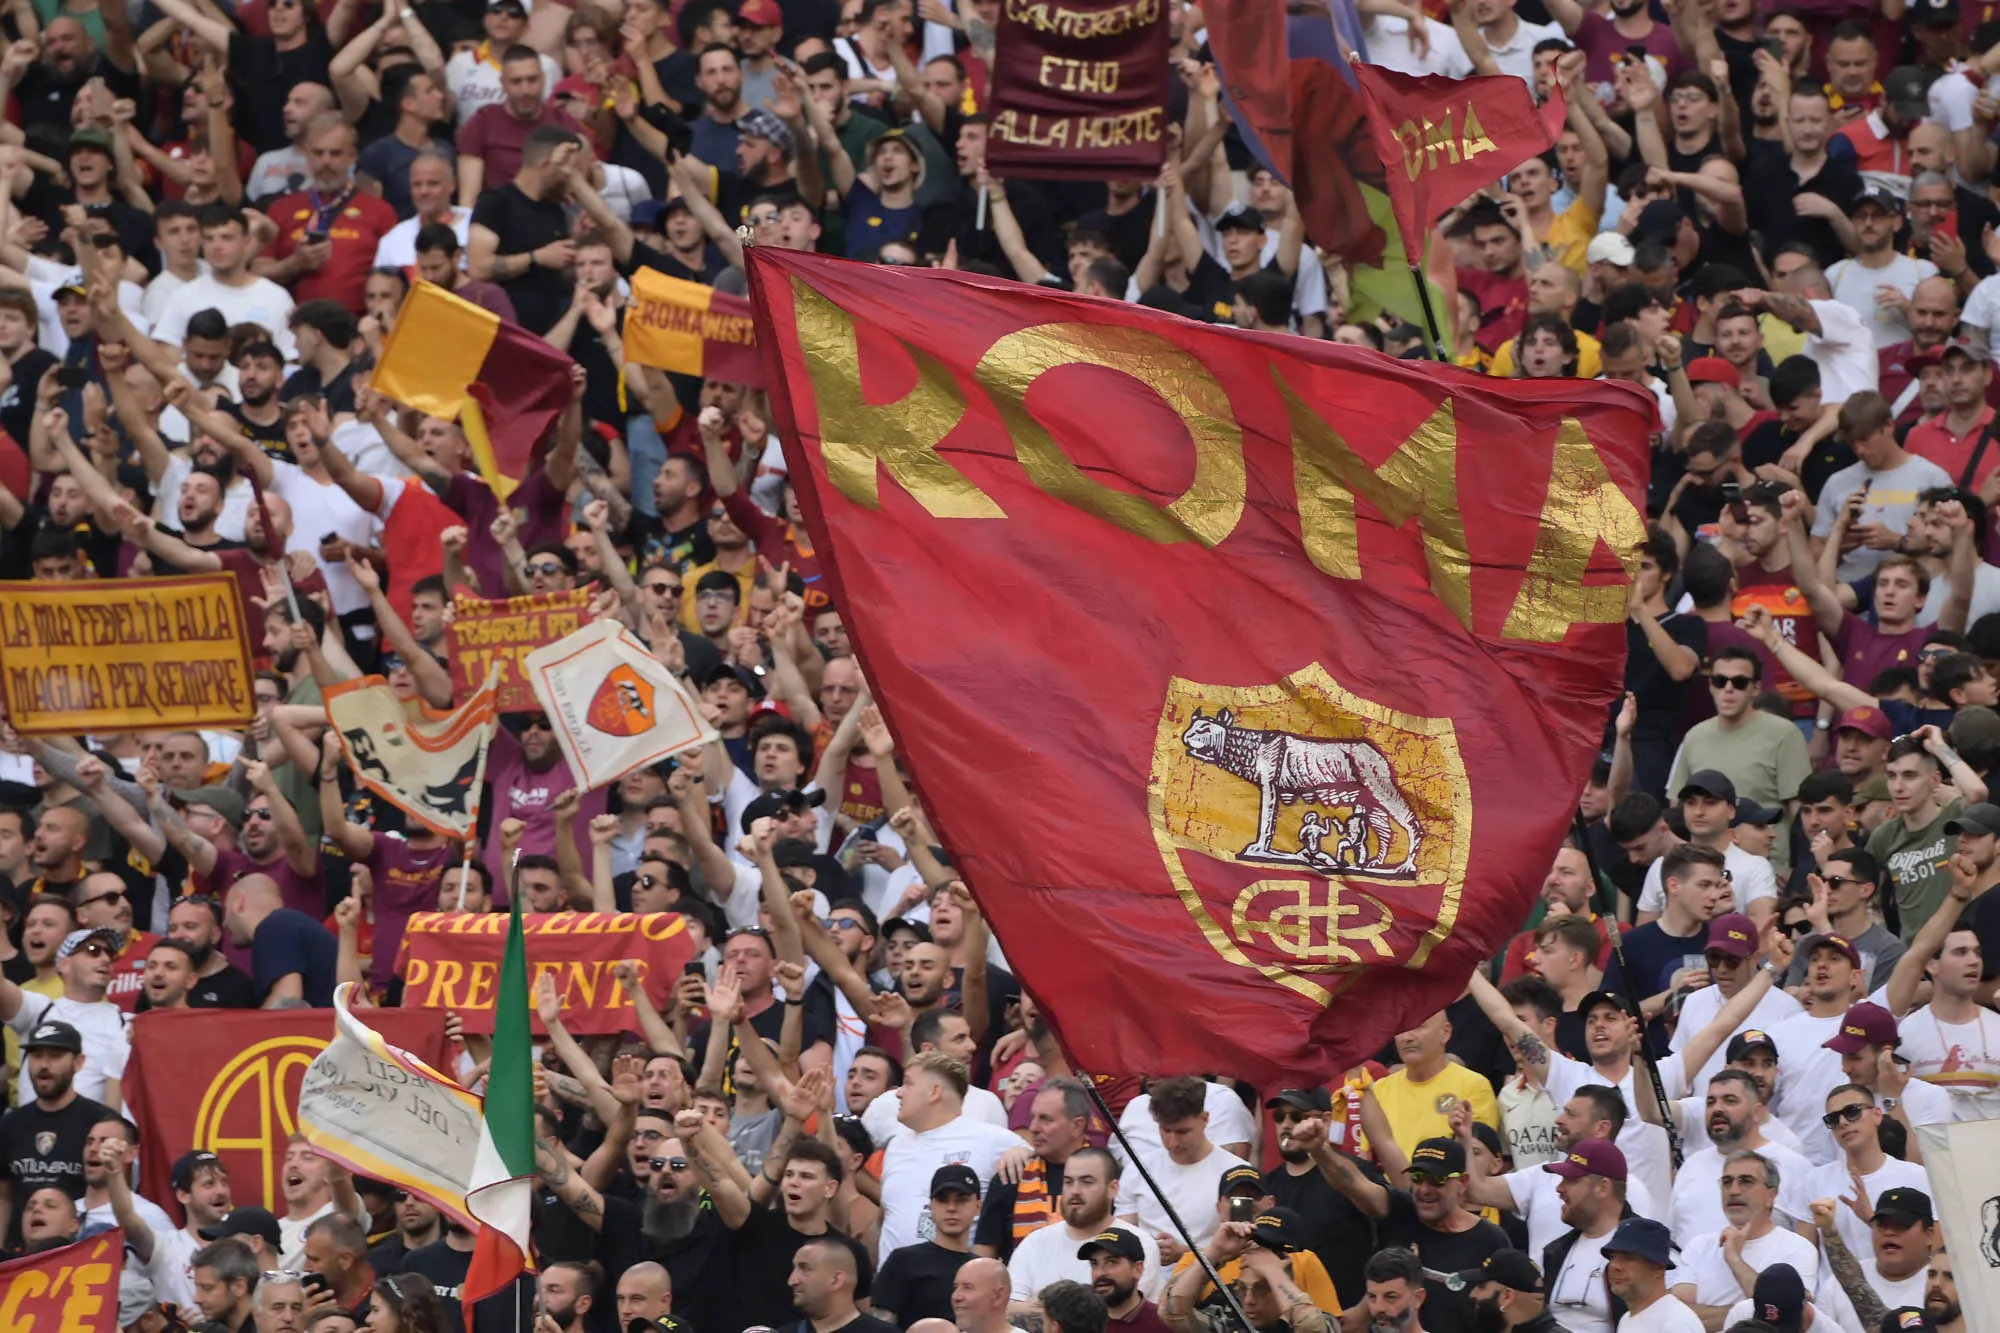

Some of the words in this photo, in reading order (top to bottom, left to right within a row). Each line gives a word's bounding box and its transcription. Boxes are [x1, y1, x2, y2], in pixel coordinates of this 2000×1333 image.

[1039, 55, 1119, 93] FINO
[989, 109, 1070, 148] ALLA
[1075, 106, 1163, 149] MORTE
[1390, 100, 1498, 182] OMA
[641, 299, 754, 346] ROMANIST
[792, 273, 1651, 643] ROMA
[0, 601, 32, 648] LA
[31, 602, 75, 659] MIA
[175, 593, 234, 642] ALLA
[9, 663, 106, 723] MAGLIA
[106, 661, 163, 717] PER
[153, 658, 245, 718] SEMPRE
[406, 958, 649, 1010] PREENTE
